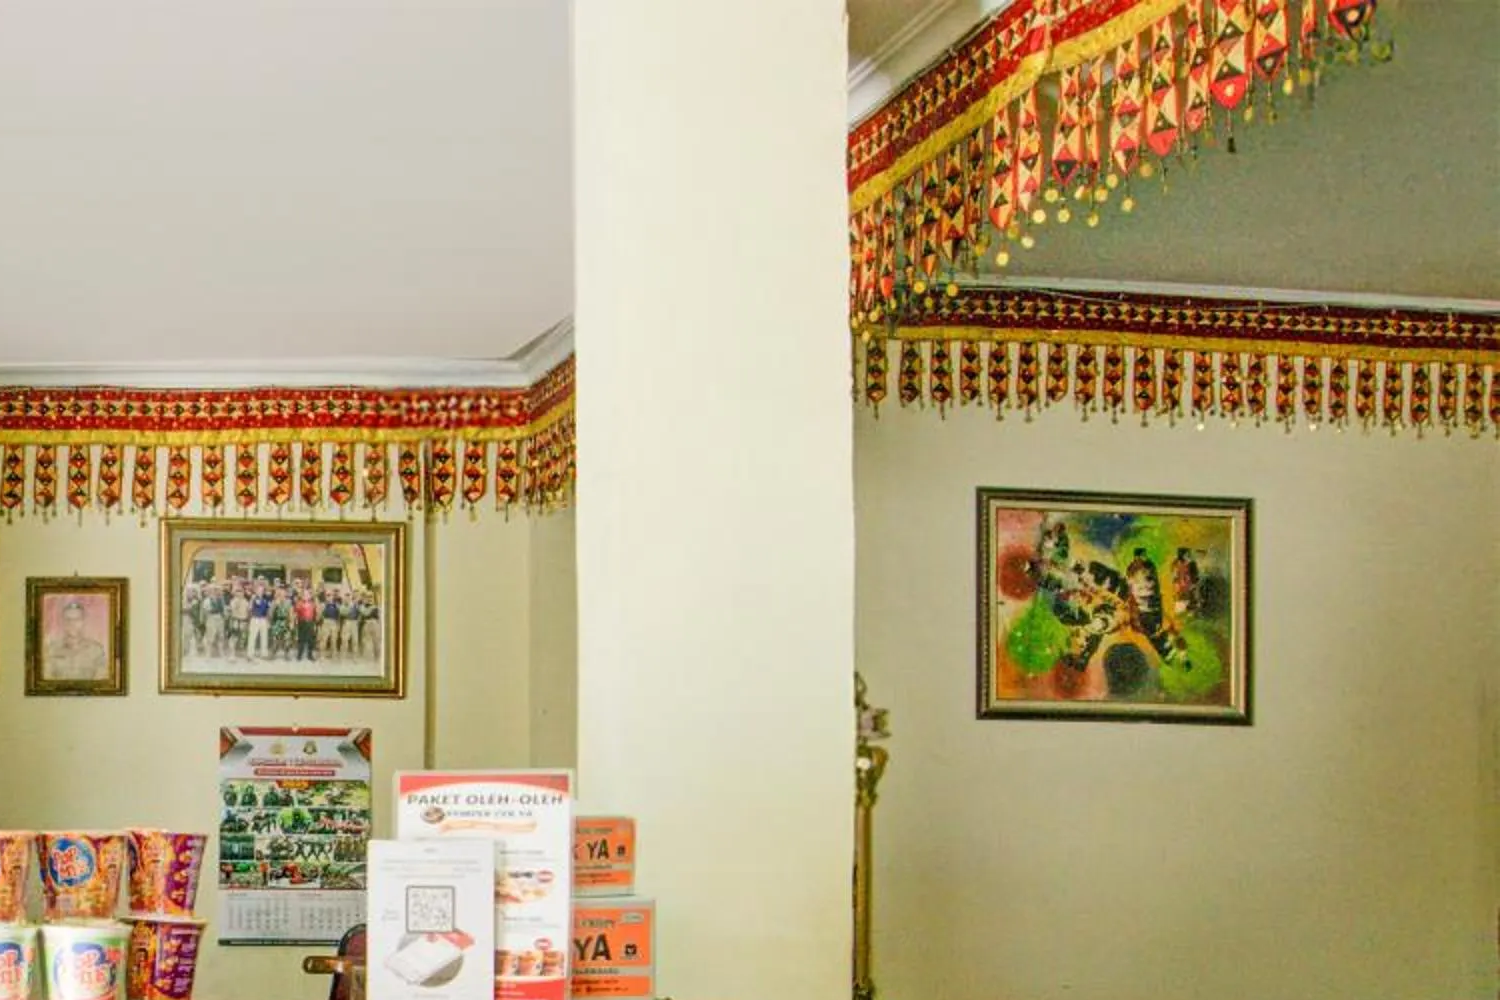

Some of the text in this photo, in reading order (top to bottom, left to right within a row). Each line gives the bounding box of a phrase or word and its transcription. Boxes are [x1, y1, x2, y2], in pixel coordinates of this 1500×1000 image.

[406, 793, 564, 806] PAKET OLEH-OLEH
[586, 837, 610, 861] YA
[573, 933, 612, 961] YA
